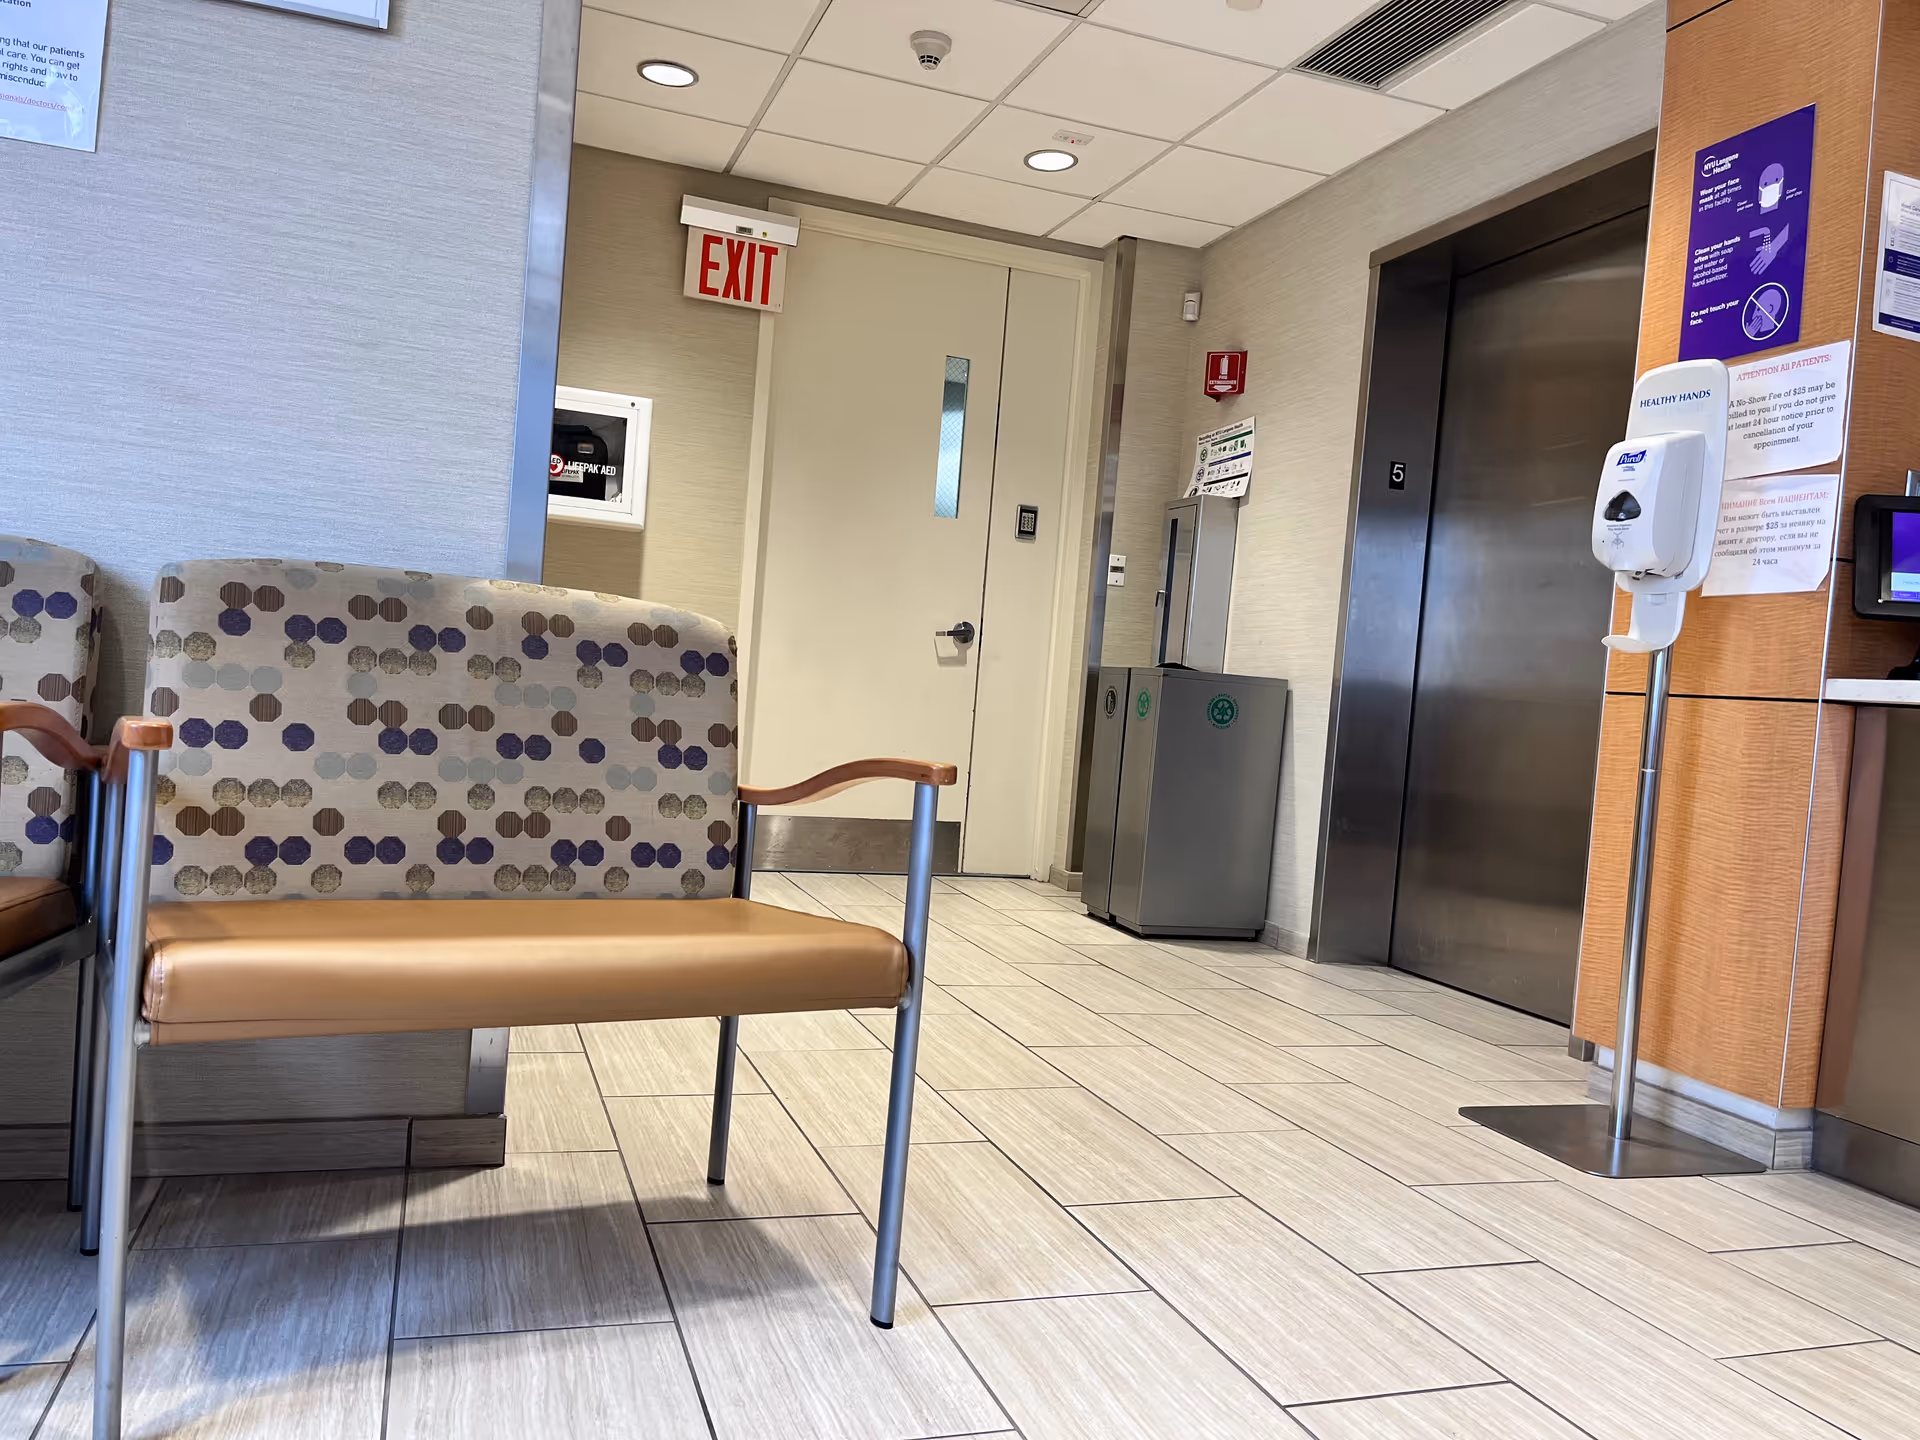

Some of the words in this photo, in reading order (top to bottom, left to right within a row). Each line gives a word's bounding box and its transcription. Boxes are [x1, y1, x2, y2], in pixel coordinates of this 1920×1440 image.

[12, 38, 30, 48] that
[32, 43, 48, 51] our
[49, 46, 85, 59] patients
[6, 50, 28, 60] care.
[30, 53, 47, 64] You
[48, 58, 65, 67] can
[66, 62, 80, 71] get
[2, 61, 29, 72] rights
[30, 66, 47, 76] and
[49, 68, 68, 80] how
[69, 73, 78, 82] to
[1703, 160, 1716, 172] NYU
[1716, 153, 1739, 167] Langone
[1713, 163, 1732, 175] Health
[1699, 195, 1714, 205] mask
[1727, 185, 1742, 194] times
[1700, 187, 1714, 197] Wear
[1714, 182, 1727, 193] your
[1727, 178, 1740, 187] face
[1704, 203, 1714, 211] this
[1694, 246, 1710, 256] Clean
[1710, 242, 1724, 252] your
[1724, 236, 1741, 246] hands
[1694, 255, 1709, 264] often
[1709, 250, 1720, 259] with
[1721, 247, 1734, 256] soap
[699, 233, 779, 306] EXIT
[1693, 263, 1703, 272] and
[1704, 259, 1718, 269] water
[1693, 264, 1728, 280] alcohol-based
[1692, 278, 1705, 288] hand
[1705, 272, 1729, 284] sanitizer.
[1709, 303, 1726, 313] touch
[1726, 299, 1740, 309] your
[1690, 318, 1704, 326] face.
[1736, 365, 1780, 382] ATTENTION
[1780, 363, 1790, 372] All
[1791, 354, 1832, 370] PATIENTS:
[1640, 394, 1677, 408] HEALTHY
[1678, 388, 1712, 402] HANDS
[1729, 400, 1735, 408] A
[1736, 395, 1768, 407] No-Show
[1768, 392, 1782, 402] Fee
[1783, 388, 1792, 397] of
[1792, 386, 1806, 397] $25
[1807, 384, 1824, 392] may
[1825, 381, 1836, 390] be
[1757, 406, 1771, 416] you
[1772, 403, 1778, 411] if
[1778, 402, 1792, 412] you
[1793, 399, 1804, 407] do
[1805, 396, 1818, 405] not
[1819, 394, 1836, 404] give
[1735, 420, 1752, 430] least
[1752, 418, 1761, 427] 24
[1762, 416, 1780, 425] hour
[1781, 412, 1804, 421] notice
[1804, 407, 1825, 419] prior
[1742, 425, 1786, 440] cancellation
[1787, 423, 1796, 432] of
[1796, 421, 1815, 432] your
[1753, 435, 1801, 450] appointment.
[568, 460, 598, 474] LIFEPAK
[601, 465, 616, 476] AED
[1392, 464, 1404, 482] 5
[1761, 510, 1779, 518] быть
[1735, 525, 1764, 535] размере
[1765, 521, 1779, 530] $25
[1718, 538, 1738, 546] визит
[1779, 533, 1796, 541] если
[1748, 546, 1758, 555] об
[1776, 543, 1811, 552] минимум
[1752, 558, 1761, 566] 24
[1762, 558, 1778, 566] часа
